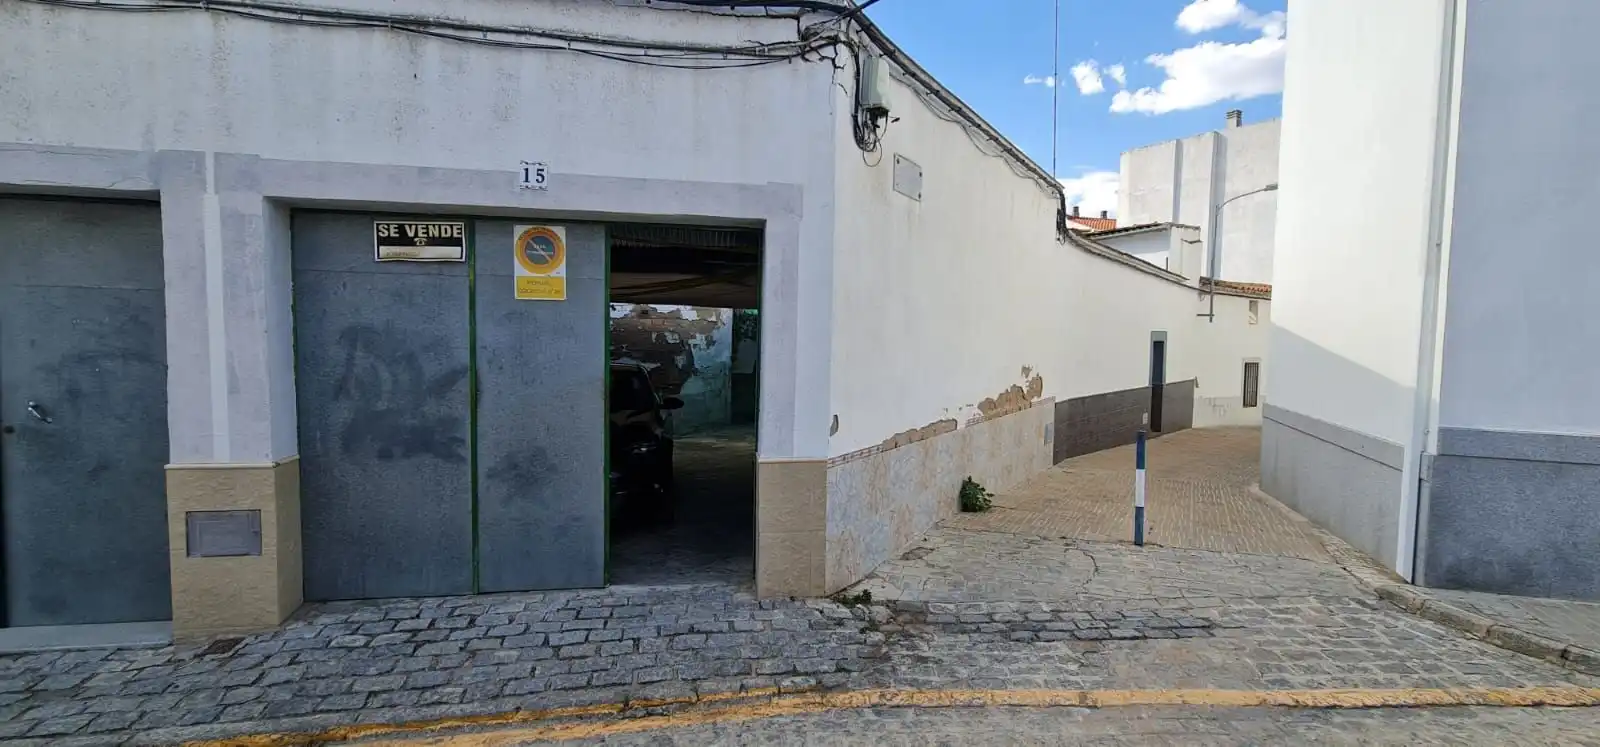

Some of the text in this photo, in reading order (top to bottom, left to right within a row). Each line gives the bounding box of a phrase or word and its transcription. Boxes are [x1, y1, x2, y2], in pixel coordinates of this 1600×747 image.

[523, 167, 545, 183] 15
[378, 224, 462, 238] SE VENDE
